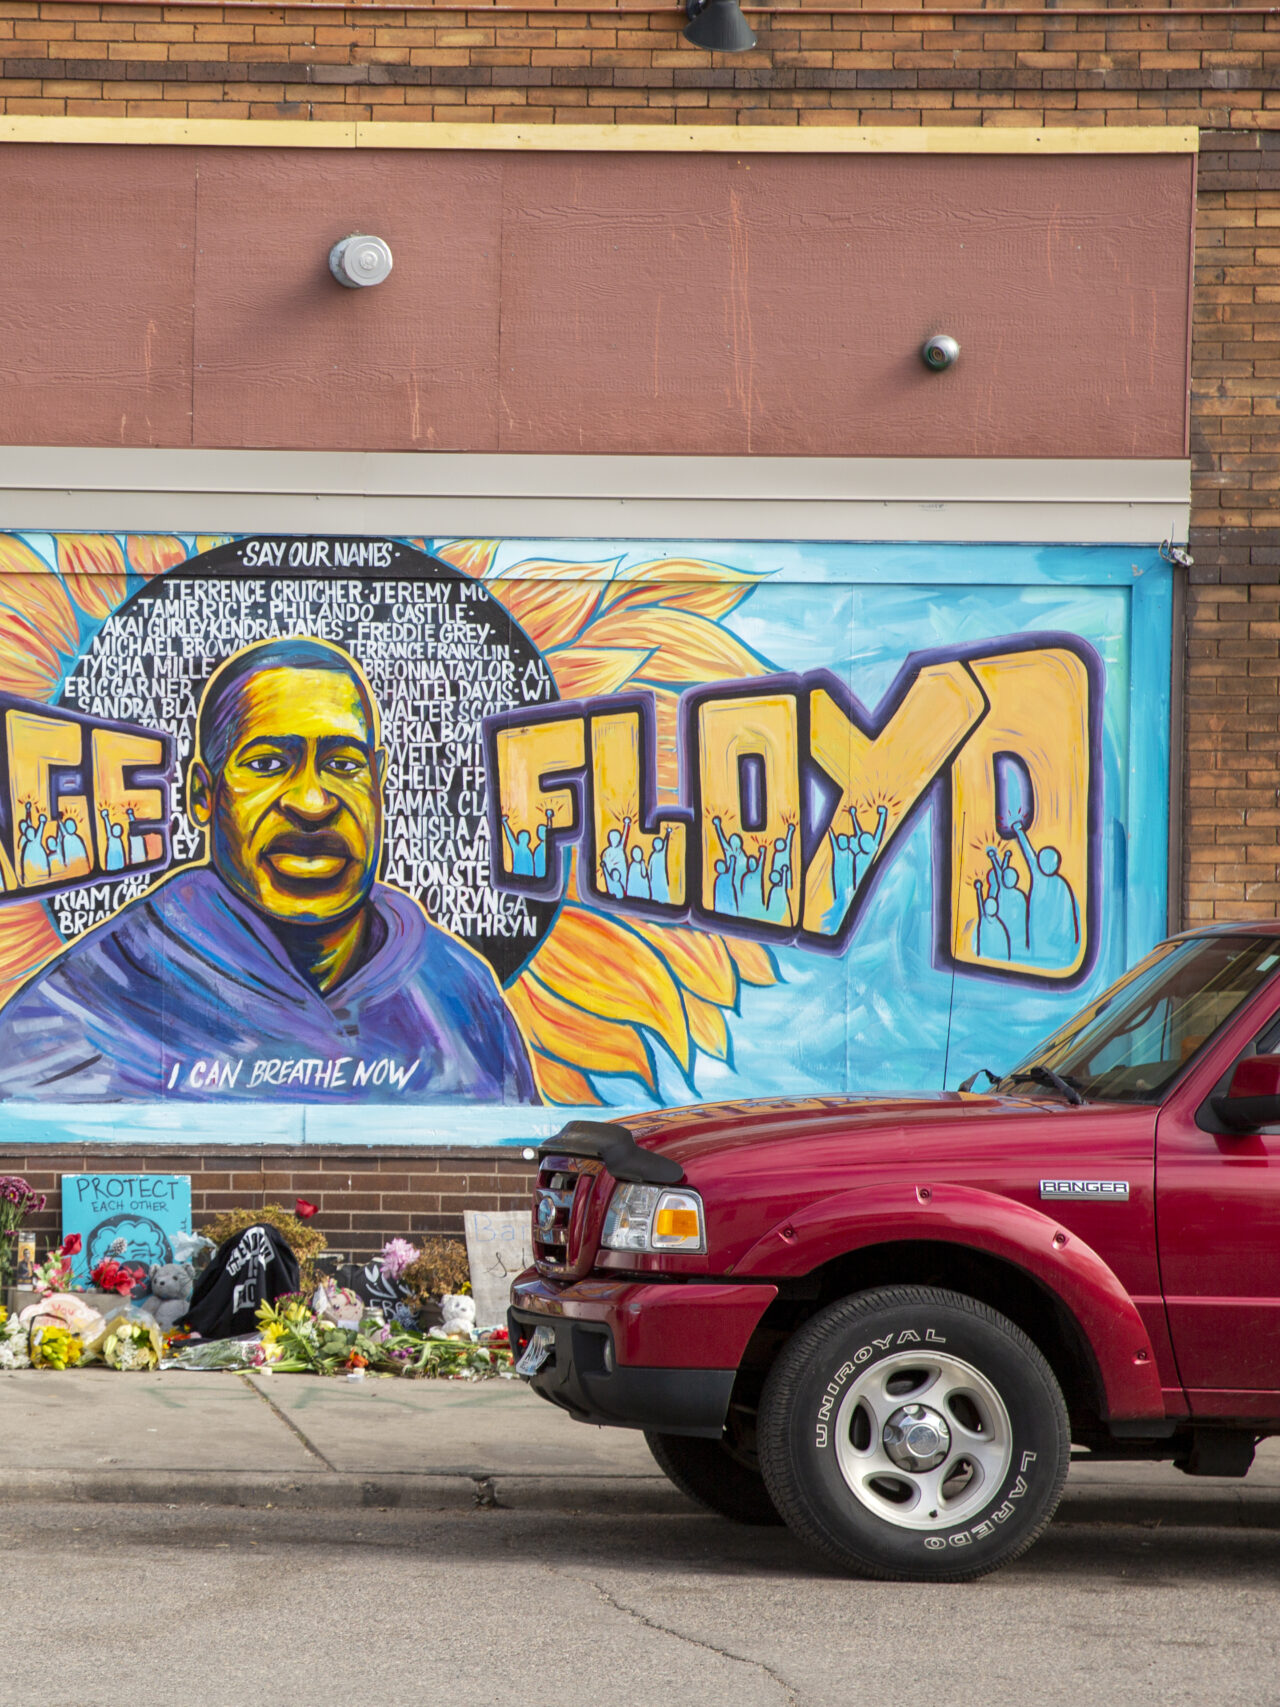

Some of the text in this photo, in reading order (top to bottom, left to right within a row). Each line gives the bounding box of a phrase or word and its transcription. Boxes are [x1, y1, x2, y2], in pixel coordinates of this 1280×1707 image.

[243, 542, 392, 568] SAY OUR NAMES
[163, 580, 266, 602] TERRENCE
[270, 580, 364, 604] CRUTCHER
[370, 582, 452, 605] JEREMY
[138, 599, 469, 625] TAMIR RICE PHILANDO CASTILE
[102, 616, 491, 645] AKAI GURLEY KENDRA JAMES FREDDIE GREY
[93, 636, 178, 657] MICHAEL
[346, 640, 426, 660] TERRANCE
[426, 642, 510, 661] FRANKLIN
[78, 655, 146, 679] TYISHA
[362, 659, 550, 682] BREONNA TAYLOR AL
[64, 677, 193, 699] ERIC GARNER
[372, 679, 457, 702] SHANTEL
[458, 680, 513, 701] DAVIS
[78, 696, 197, 719] SANDRA BLA
[376, 701, 456, 722] WALTER
[380, 721, 436, 743] REKIA
[443, 743, 481, 768] SMI
[385, 765, 455, 792] SHELLY
[382, 790, 453, 816] JAMAR
[482, 630, 1105, 992] FLOYD
[384, 816, 469, 841] TANISHA
[384, 838, 462, 862] TARIKA
[384, 860, 490, 887] ALTON STE
[437, 913, 537, 937] KATHRYN
[167, 1057, 420, 1091] I CAN BREATHE NOW
[76, 1177, 179, 1202] PROTECT
[1042, 1181, 1127, 1193] RANGER
[91, 1200, 169, 1213] EACH OTHER
[816, 1329, 946, 1448] UNIROYAL
[924, 1451, 1037, 1550] LAREDO
